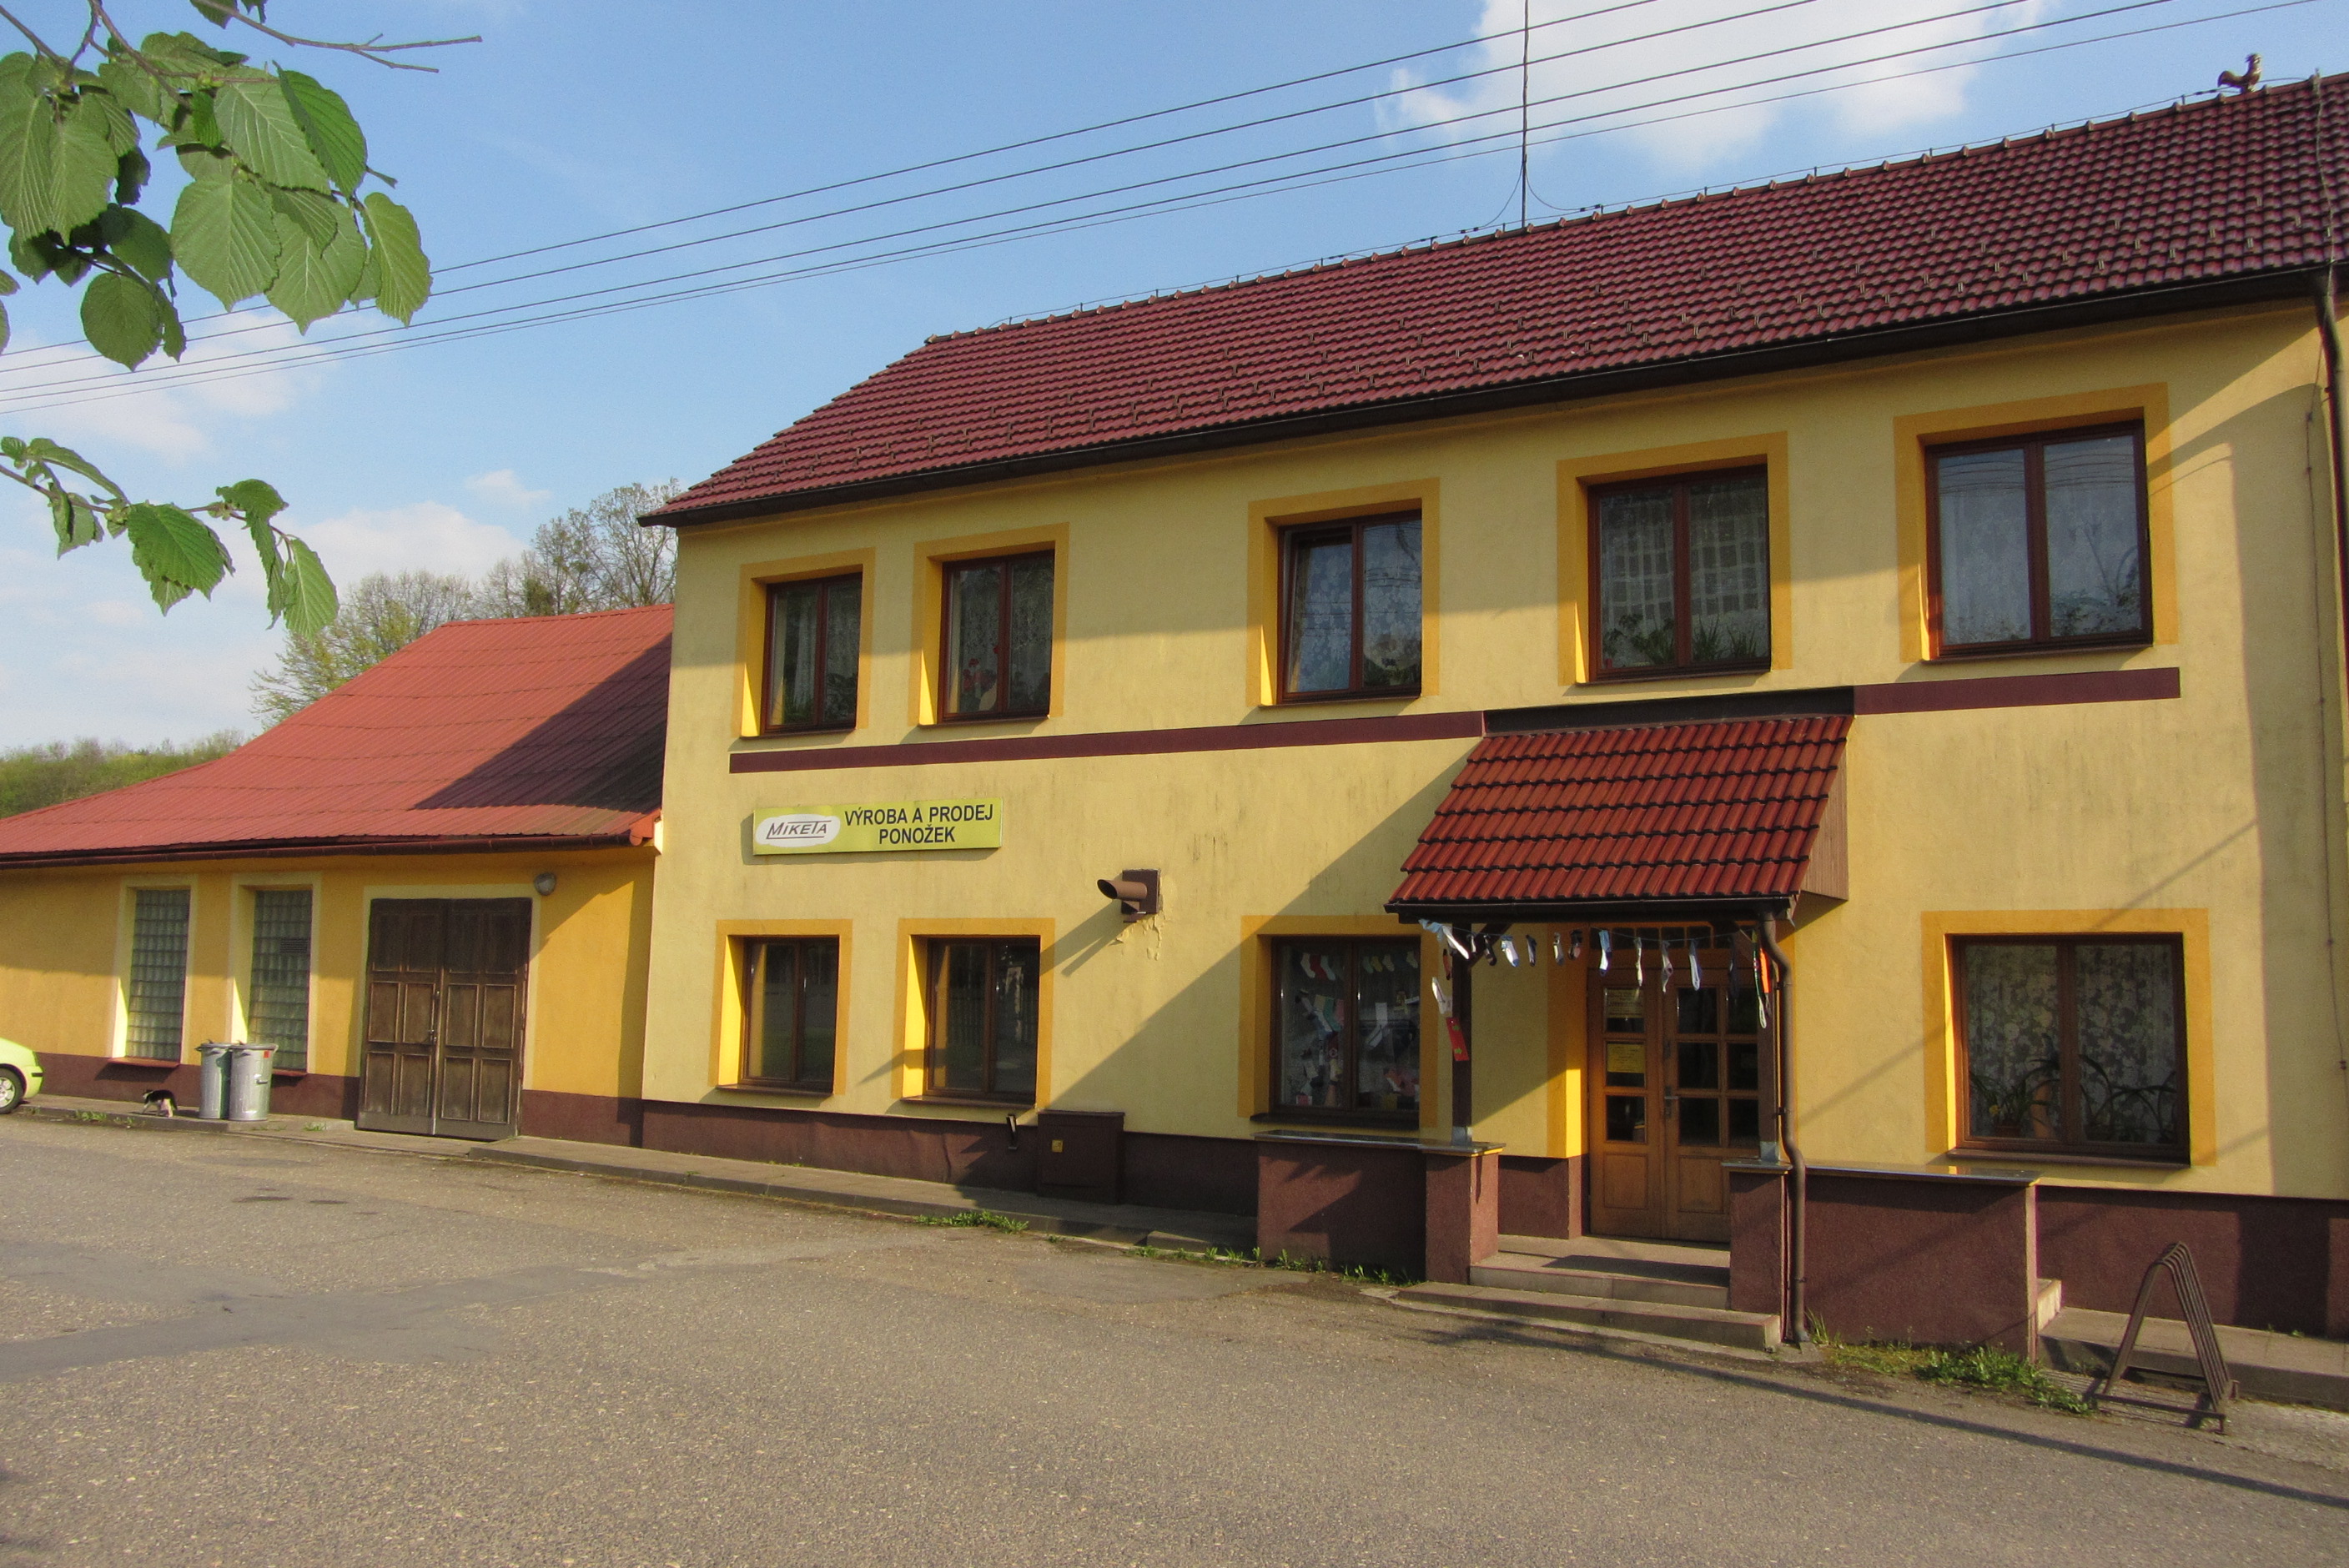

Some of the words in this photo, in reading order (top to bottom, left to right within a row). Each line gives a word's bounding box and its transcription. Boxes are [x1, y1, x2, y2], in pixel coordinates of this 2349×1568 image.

[844, 807, 908, 826] VÝROBA
[912, 807, 923, 823] A
[929, 804, 993, 822] PRODEJ
[766, 820, 832, 839] MIKETA
[879, 824, 956, 844] PONOŽEK
